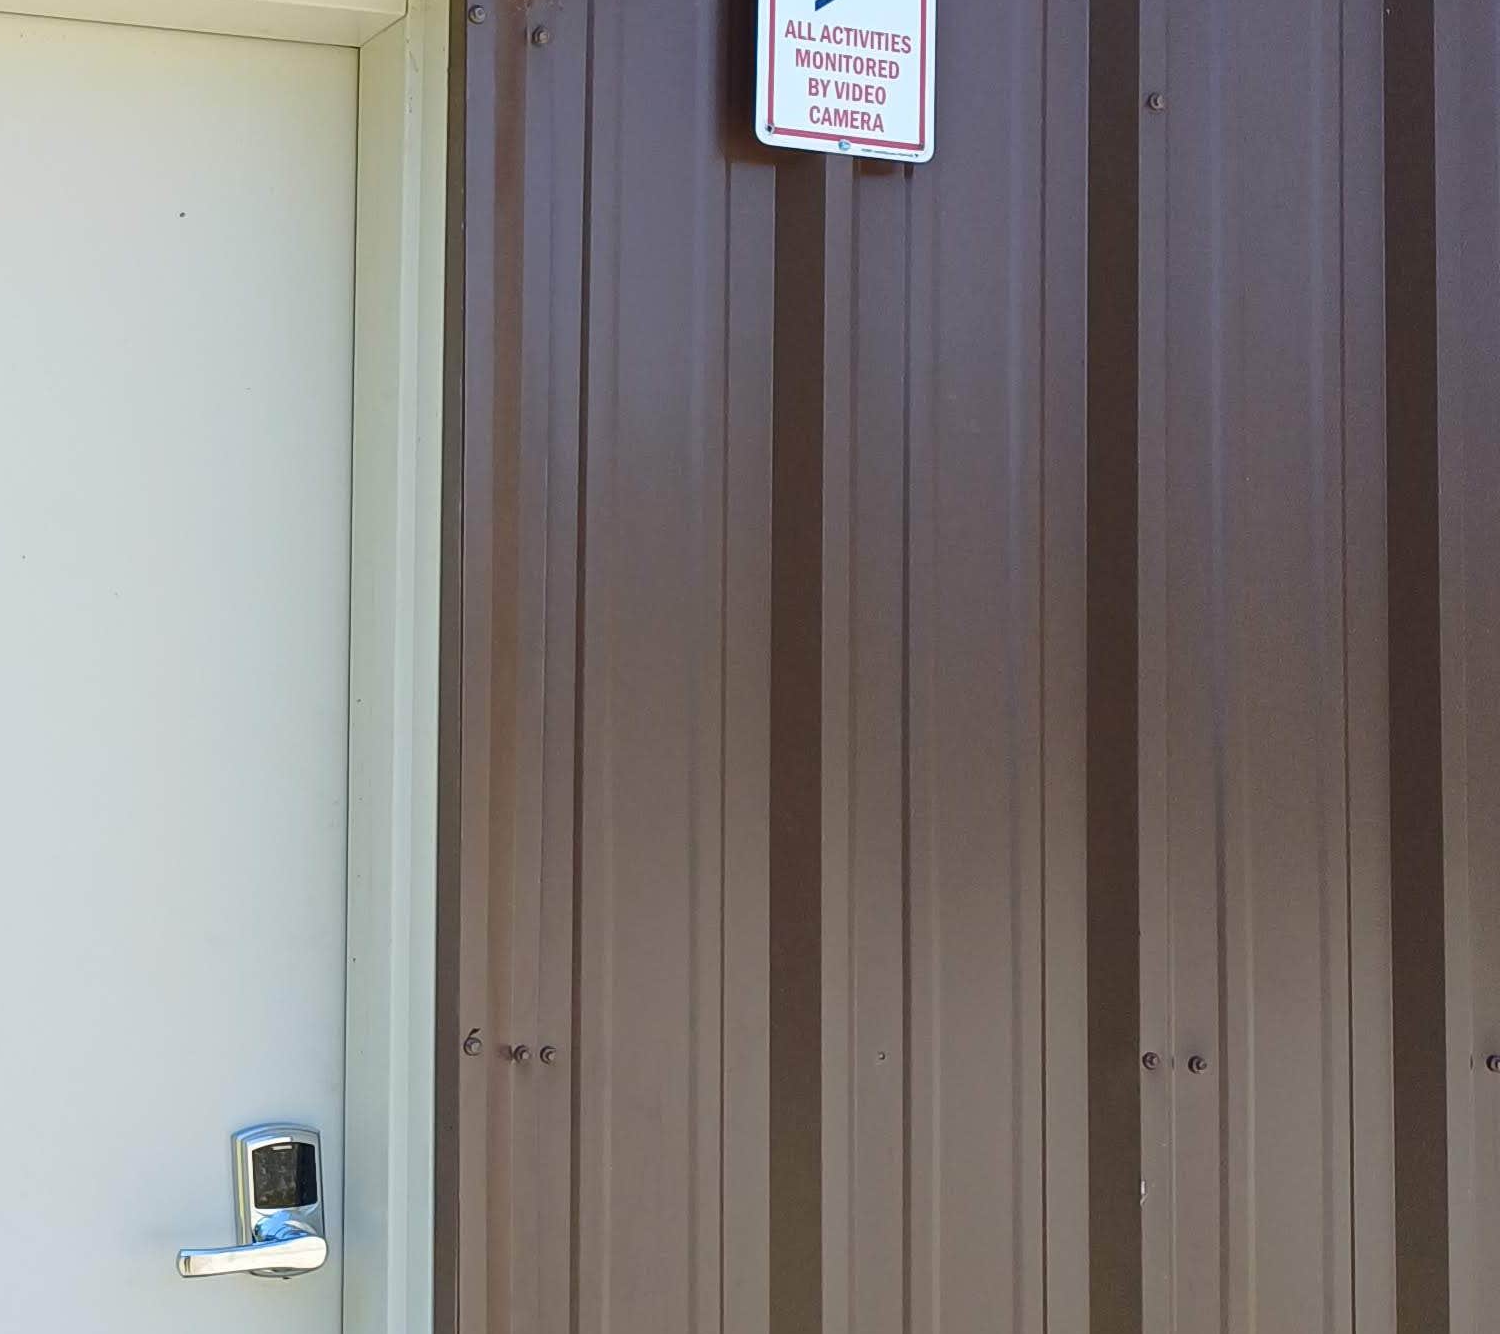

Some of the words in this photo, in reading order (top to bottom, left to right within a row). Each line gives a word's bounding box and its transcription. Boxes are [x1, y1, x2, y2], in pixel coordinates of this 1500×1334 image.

[785, 19, 815, 41] ALL
[820, 25, 911, 53] ACTIVITIES
[795, 48, 898, 78] MONITORED
[808, 77, 830, 96] BY
[835, 81, 885, 104] VIDEO
[809, 105, 883, 131] CAMERA
